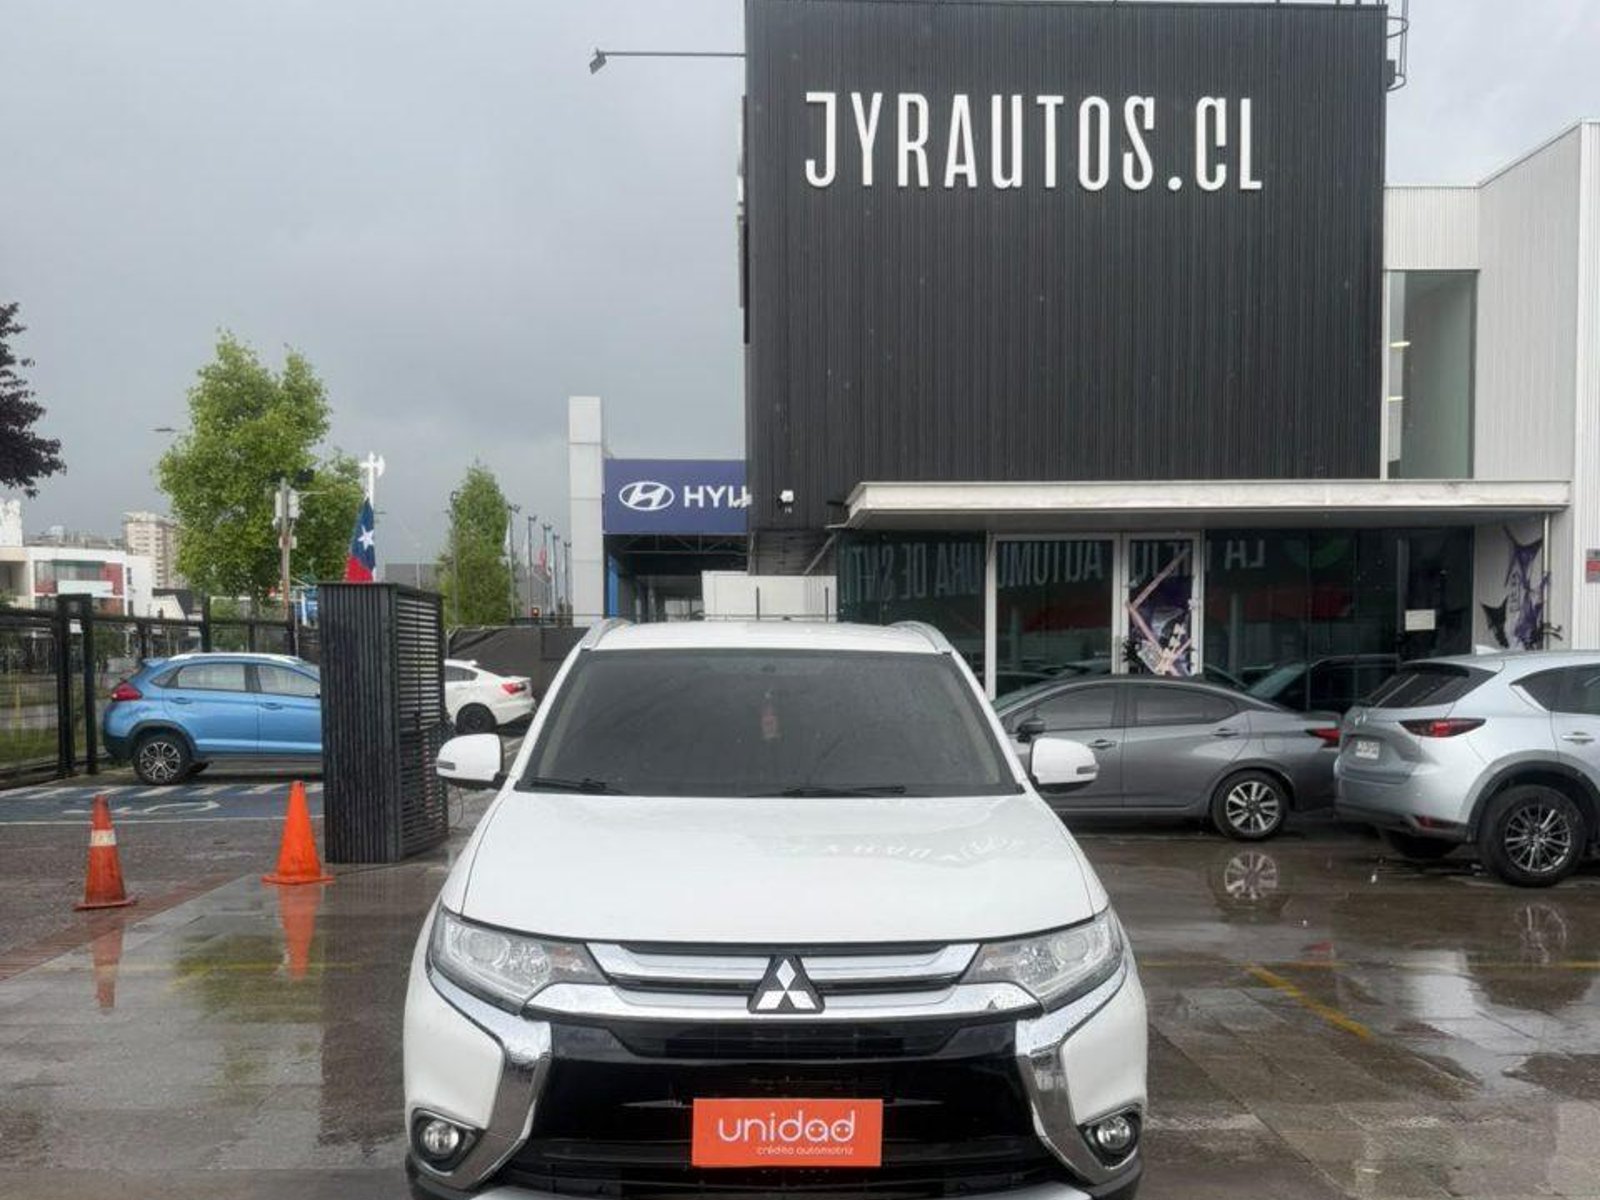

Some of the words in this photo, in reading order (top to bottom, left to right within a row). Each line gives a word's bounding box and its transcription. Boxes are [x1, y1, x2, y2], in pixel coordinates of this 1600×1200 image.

[805, 91, 1264, 191] JYRAUTOS.CL
[718, 1109, 855, 1142] unidad
[757, 1145, 795, 1156] crédito
[796, 1146, 853, 1156] automotriz
